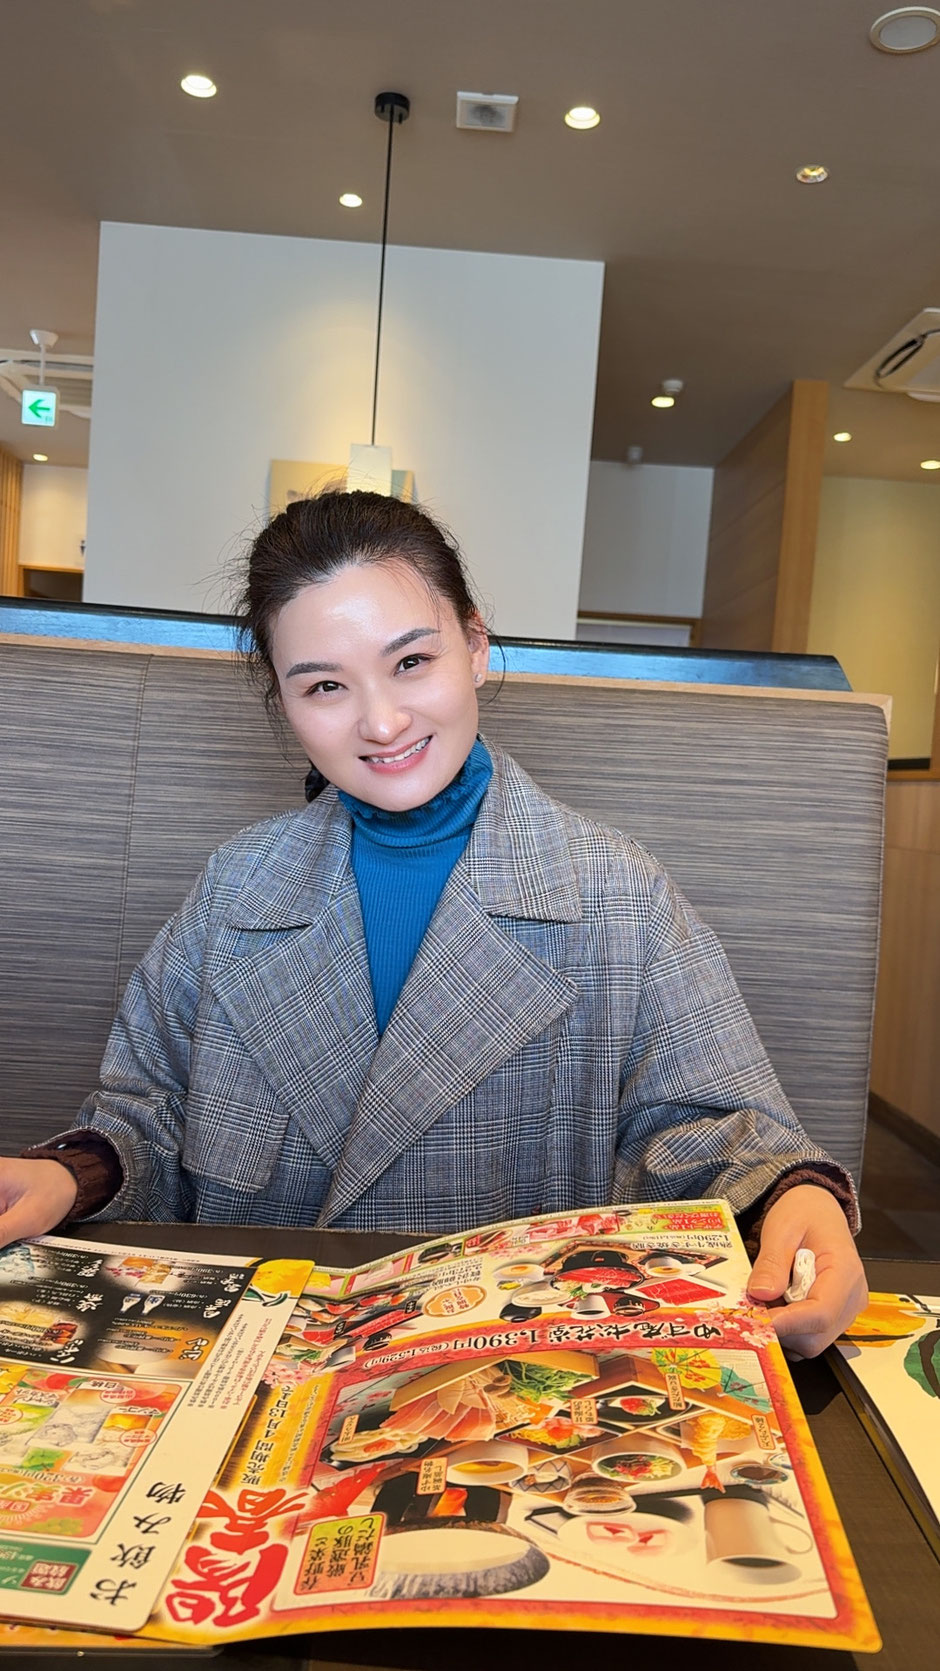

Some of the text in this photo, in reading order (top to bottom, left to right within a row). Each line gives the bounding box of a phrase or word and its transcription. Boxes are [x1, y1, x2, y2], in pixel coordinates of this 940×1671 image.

[178, 1337, 209, 1361] ビール
[453, 1329, 538, 1350] 1,390円
[548, 1323, 630, 1343] 松花堂
[633, 1322, 721, 1340] ゆず庵
[90, 1380, 118, 1389] 白桃
[118, 1406, 160, 1416] マンゴー
[241, 1385, 295, 1486] 販売期間 4月13日まで
[89, 1480, 188, 1607] お飲み物
[164, 1487, 310, 1628] 陽春
[326, 1524, 354, 1579] 厳選豚の
[350, 1517, 377, 1586] 豆乳鍋だし
[300, 1536, 328, 1593] 春野菜と
